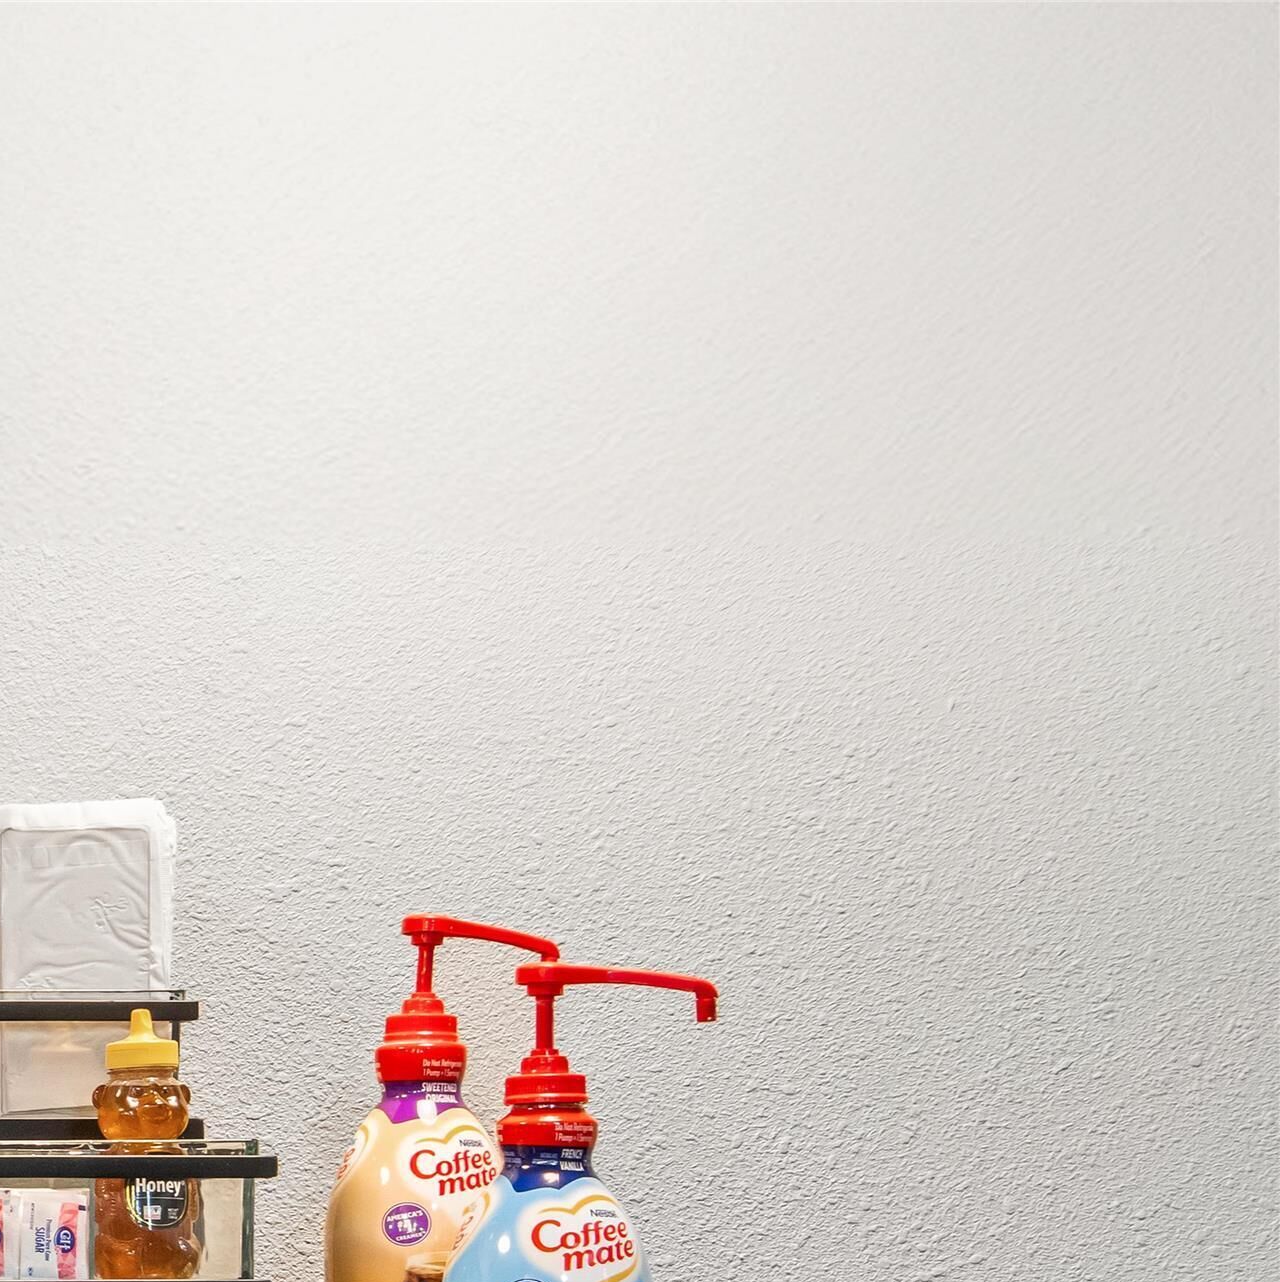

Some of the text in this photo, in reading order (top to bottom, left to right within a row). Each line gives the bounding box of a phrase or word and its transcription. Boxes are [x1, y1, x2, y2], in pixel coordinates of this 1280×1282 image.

[410, 1149, 492, 1180] Coffee
[438, 1167, 497, 1196] mate
[35, 1227, 45, 1253] SUGAR
[531, 1219, 628, 1253] Coffee
[562, 1240, 634, 1271] mate
